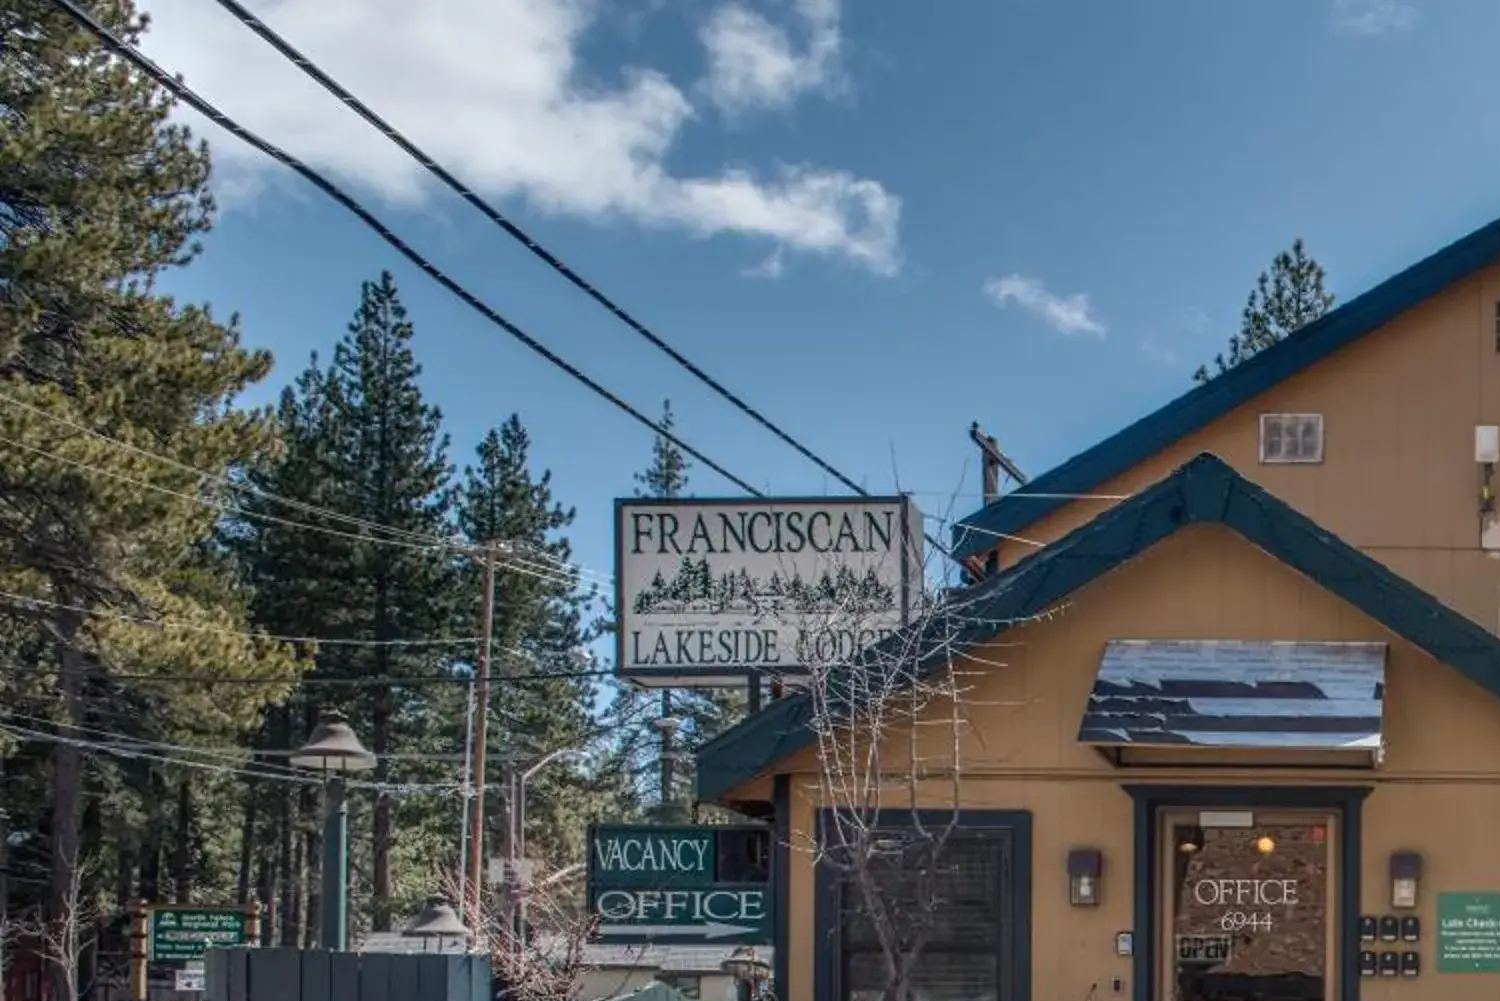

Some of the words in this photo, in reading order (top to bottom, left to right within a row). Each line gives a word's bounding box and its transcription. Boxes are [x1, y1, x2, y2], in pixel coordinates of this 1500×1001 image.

[631, 511, 895, 554] FRANCISCAN
[632, 630, 781, 665] LAKESIDE
[594, 836, 709, 871] VACANCY
[597, 890, 766, 919] OFFICE
[1194, 879, 1299, 905] OFFICE
[1221, 911, 1273, 932] 6944
[1180, 936, 1229, 958] OPEN
